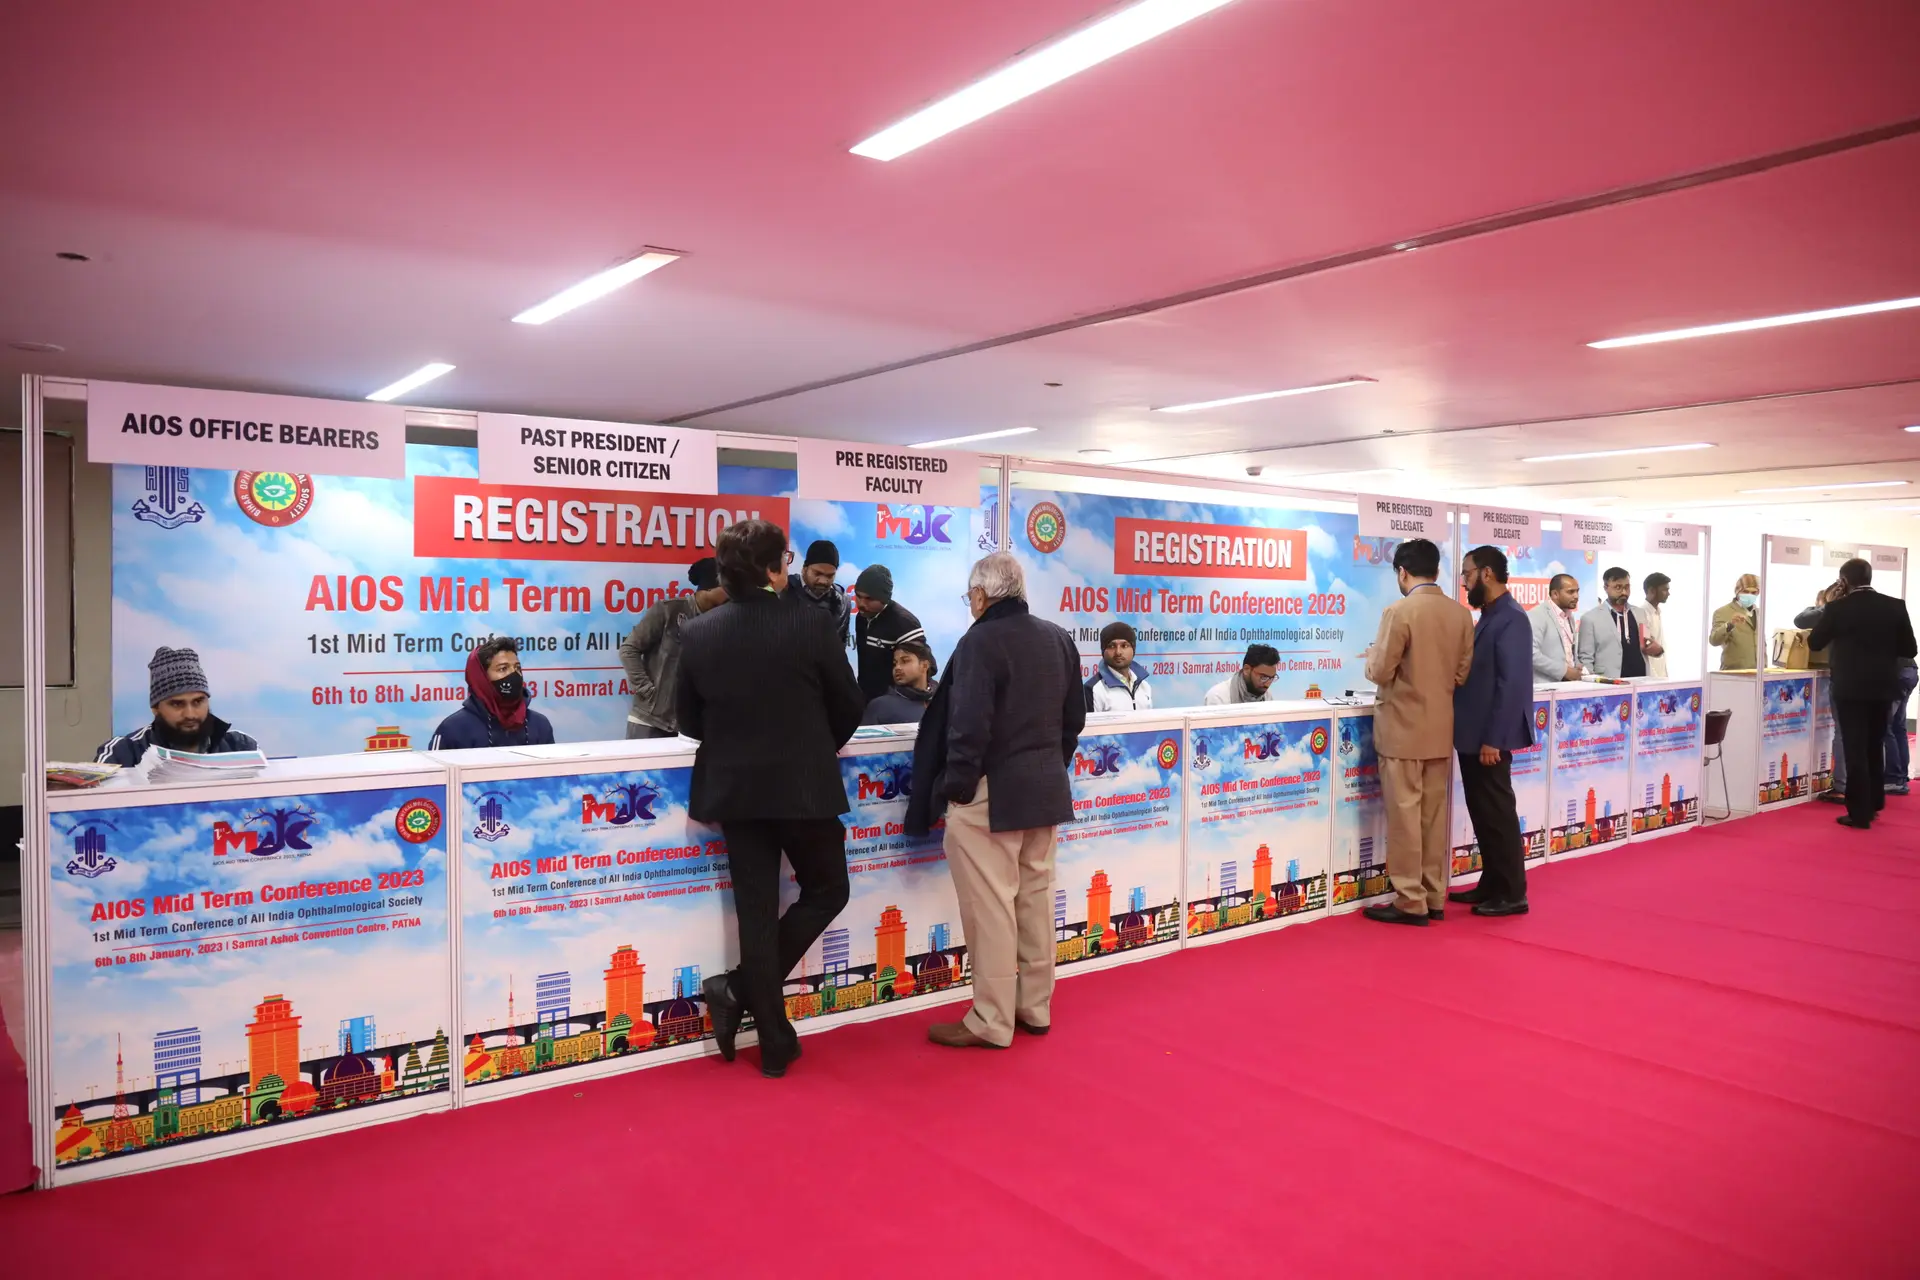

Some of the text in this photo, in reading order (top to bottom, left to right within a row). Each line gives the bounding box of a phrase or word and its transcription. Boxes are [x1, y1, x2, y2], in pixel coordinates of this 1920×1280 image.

[121, 413, 379, 450] AIOS OFFICE BEARERS
[521, 427, 680, 458] PAST PRESIDENT /
[533, 456, 671, 481] SENIOR CITIZEN
[835, 450, 948, 473] PRE REGISTERED
[865, 476, 923, 494] FACULTY
[241, 494, 261, 517] BIHAR
[290, 488, 310, 519] SOCIETY
[1376, 501, 1433, 517] PRE REGISTERED
[1391, 519, 1424, 533] DELEGATE
[1483, 512, 1529, 526] PRE REGISTERED
[1574, 520, 1613, 532] PRE REGISTERED
[1493, 528, 1521, 540] DELEGATE
[1582, 534, 1606, 545] DELEGATE
[1664, 527, 1682, 537] ON SPOT
[1134, 530, 1292, 569] REGISTRATION
[1658, 540, 1688, 549] REGISTRATION
[305, 575, 404, 612] AIOS
[419, 576, 490, 612] Mid
[502, 578, 591, 612] Term
[1059, 586, 1346, 615] AIOS Mid Term Conference 2023
[307, 633, 339, 654] 1st
[348, 633, 386, 653] Mid
[393, 633, 443, 653] Term
[564, 632, 580, 651] of
[586, 632, 609, 651] All
[1079, 628, 1099, 642] Mid
[1188, 628, 1197, 641] of
[1200, 628, 1212, 641] All
[1215, 628, 1237, 641] India
[1240, 628, 1313, 643] Ophthalmological
[1315, 628, 1344, 643] Society
[1153, 662, 1174, 676] 2023
[1183, 661, 1213, 674] Samrat
[1216, 661, 1240, 674] Ashok
[1289, 659, 1315, 672] Centre,
[1318, 658, 1342, 670] PATNA
[312, 686, 342, 706] 6th
[350, 686, 368, 705] to
[375, 684, 404, 704] 8th
[411, 684, 468, 702] Janua
[554, 679, 613, 699] Samrat
[1201, 770, 1320, 796] AIOS Mid Term Conference 2023
[1345, 767, 1360, 778] AIOS
[1095, 792, 1146, 808] Conference
[1149, 787, 1170, 800] 2023
[1099, 813, 1110, 821] India
[1153, 804, 1169, 813] Society
[851, 825, 881, 840] Term
[1066, 833, 1077, 842] 2023
[1082, 830, 1098, 839] Samrat
[870, 845, 878, 854] of
[879, 843, 887, 852] All
[889, 841, 904, 851] India
[491, 859, 531, 879] AIOS
[536, 856, 567, 874] Mid
[572, 853, 612, 870] Term
[616, 845, 702, 866] Conference
[848, 864, 863, 874] 2023
[868, 861, 889, 872] Samrat
[492, 888, 505, 897] 1st
[507, 885, 524, 895] Mid
[527, 882, 548, 893] Term
[550, 878, 597, 891] Conference
[599, 875, 608, 885] of
[609, 873, 620, 883] All
[622, 871, 642, 882] India
[644, 863, 710, 880] Ophthalmological
[91, 869, 425, 922] AIOS Mid Term Conference 2023
[493, 909, 507, 919] 6th
[508, 908, 517, 917] to
[519, 907, 532, 916] 8th
[533, 903, 567, 914] January,
[569, 899, 588, 909] 2023
[594, 895, 622, 906] Samrat
[623, 892, 645, 902] Ashok
[647, 887, 686, 898] Convention
[687, 884, 713, 894] Centre,
[92, 895, 423, 943] 1st Mid Term Conference of All India Ophthalmological Society
[95, 917, 421, 968] 6th to 8th January, 2023 Samrat Ashok Convention Centre, PATNA
